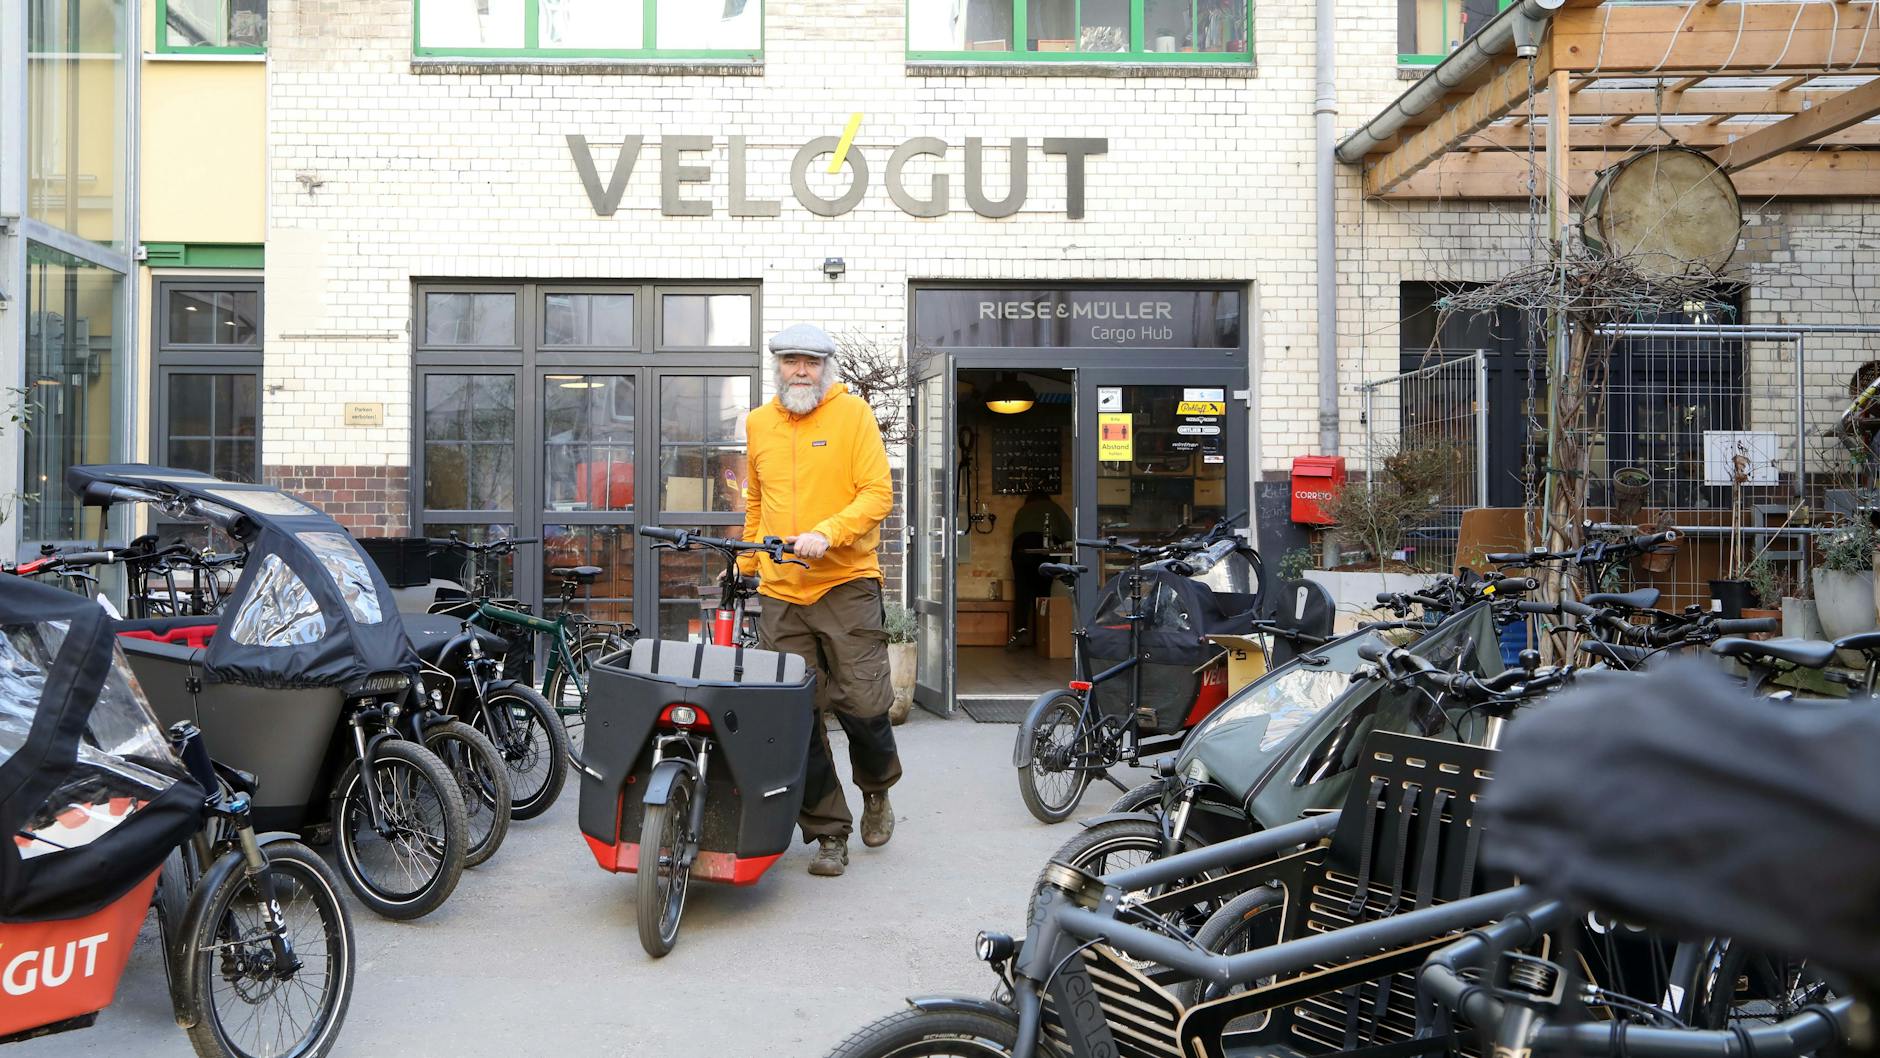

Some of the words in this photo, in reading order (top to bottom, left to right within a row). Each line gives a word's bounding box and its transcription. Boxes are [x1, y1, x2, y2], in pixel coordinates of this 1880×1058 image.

[979, 301, 1051, 319] RIESE
[1073, 301, 1172, 319] MÜLLER
[1091, 325, 1136, 343] Cargo
[1142, 325, 1173, 340] Hub
[0, 933, 109, 996] GUT
